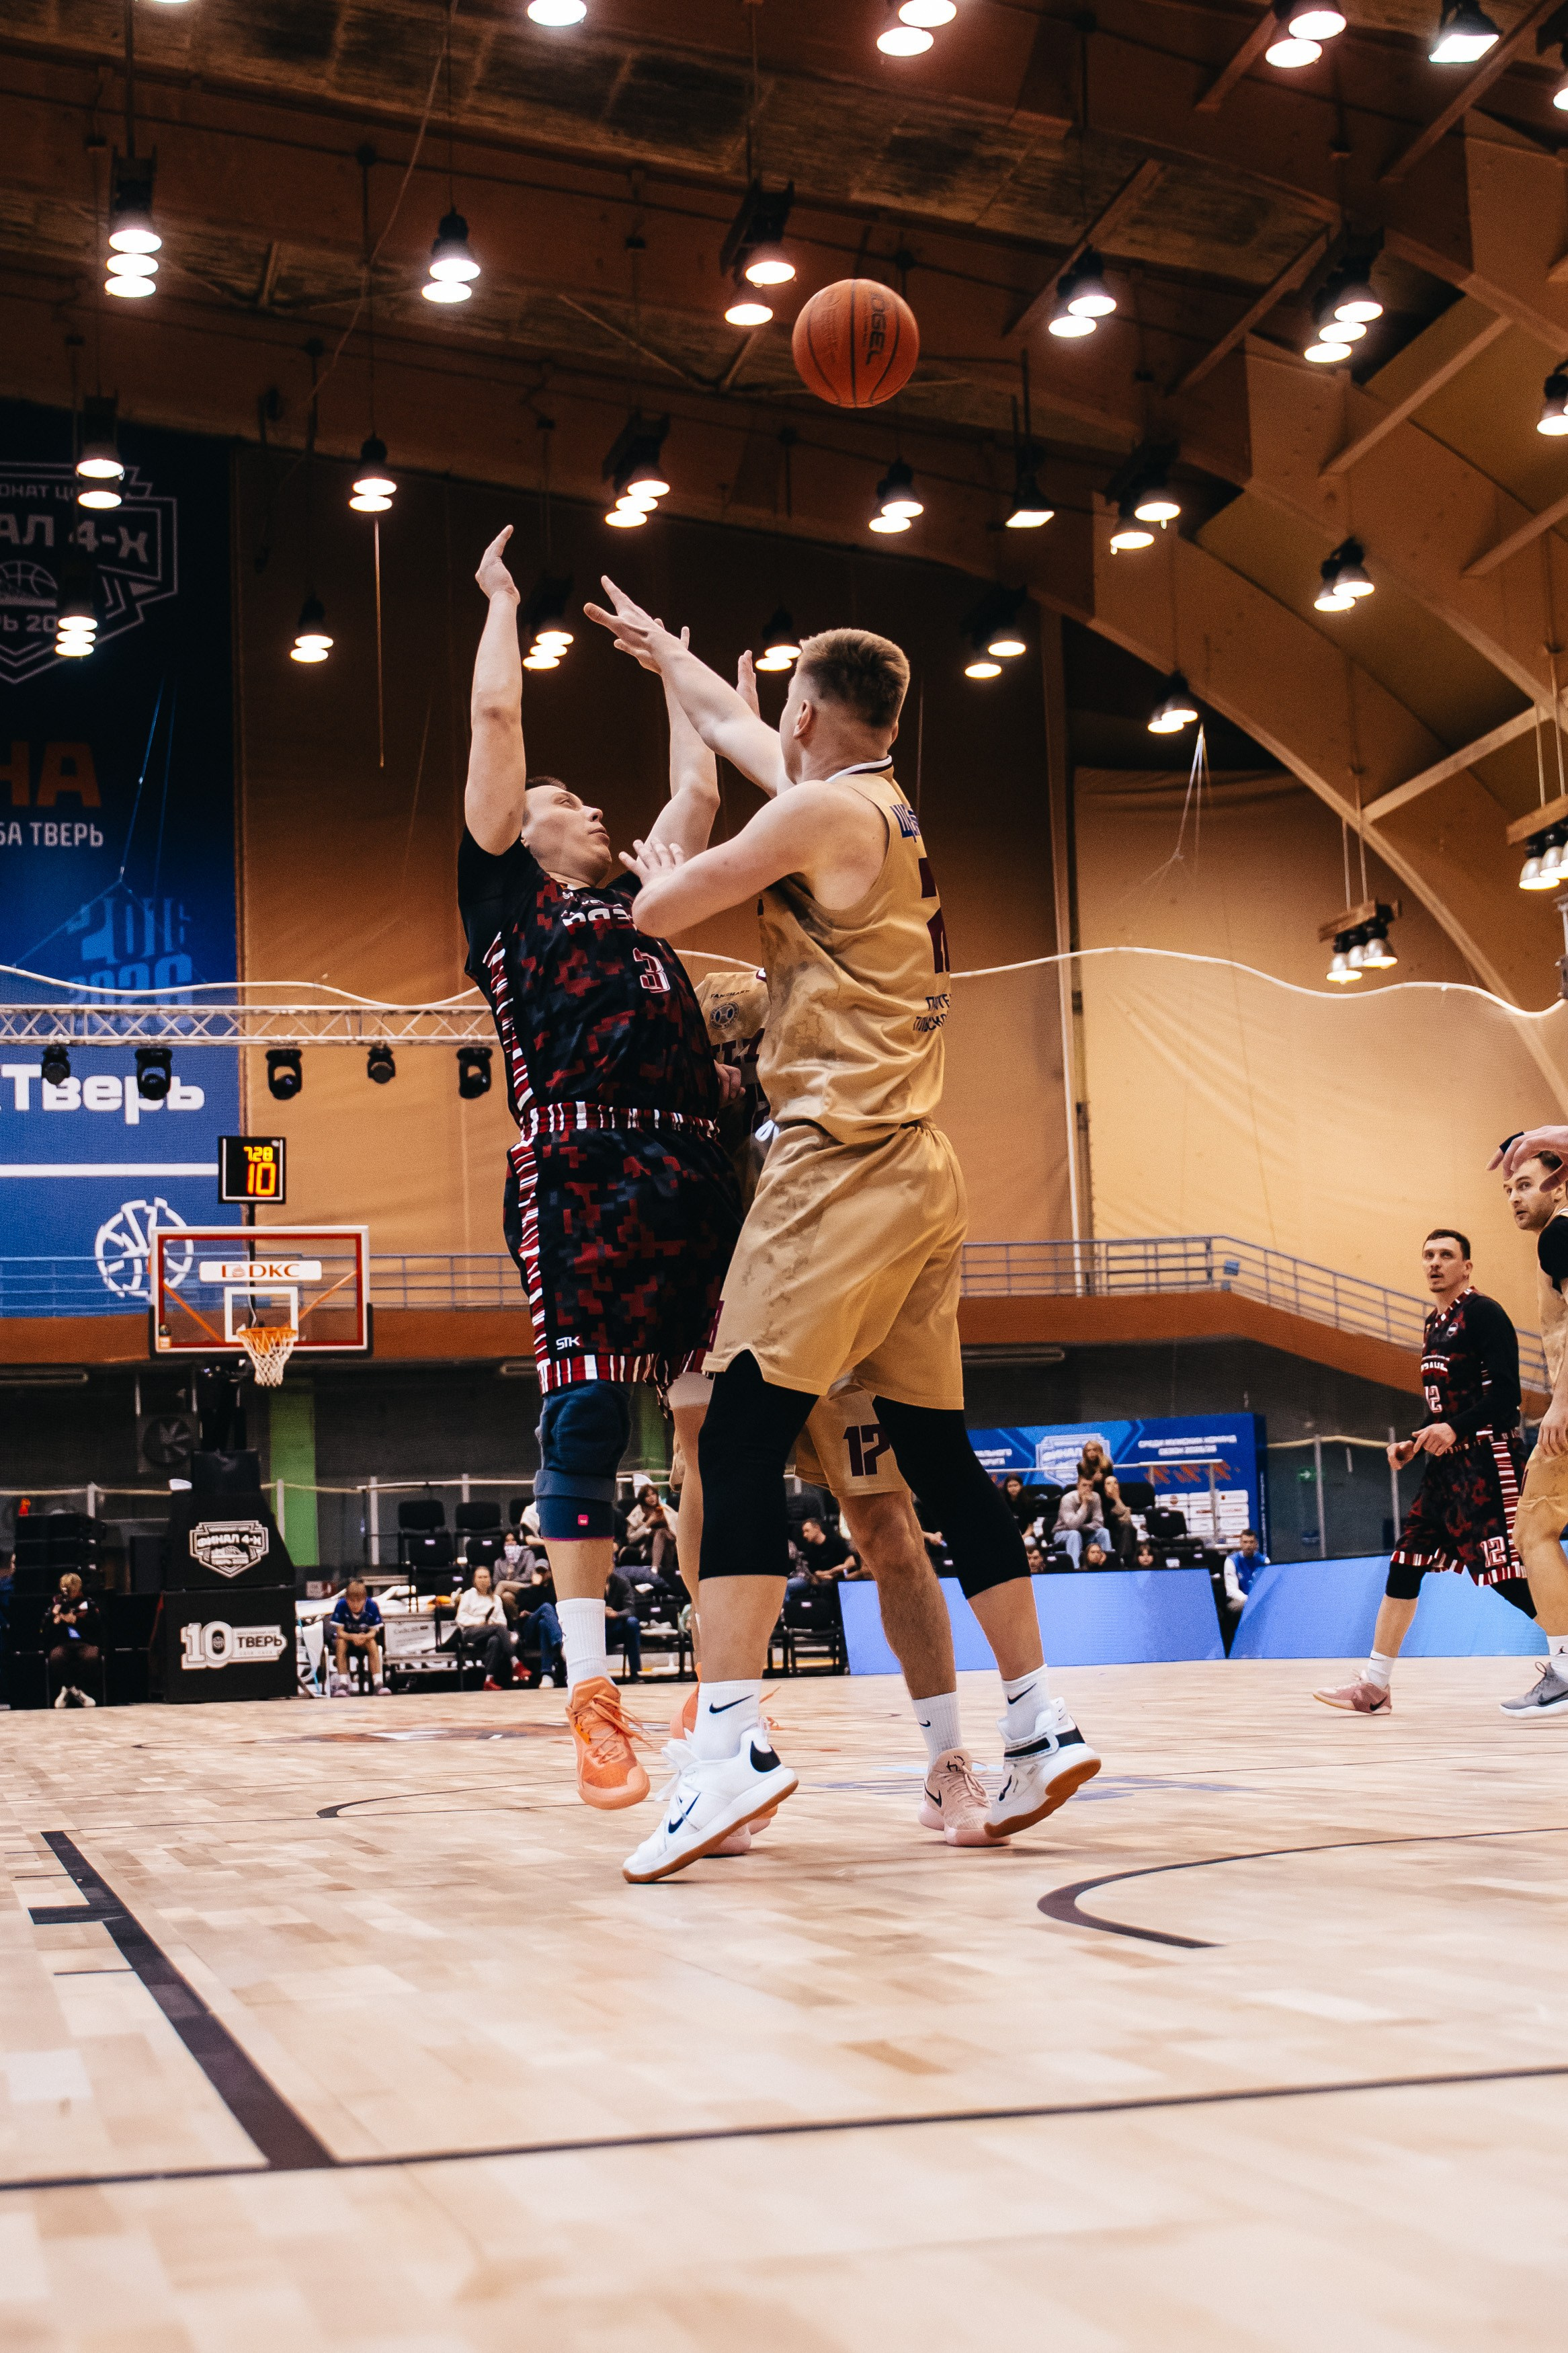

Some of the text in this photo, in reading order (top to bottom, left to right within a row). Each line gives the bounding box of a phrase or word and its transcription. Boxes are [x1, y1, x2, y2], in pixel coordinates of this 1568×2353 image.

[30, 822, 104, 847] ТВЕРЬ
[632, 947, 671, 994] 3
[1, 1064, 205, 1125] Тверь
[247, 1162, 276, 1196] 10
[556, 1336, 580, 1350] STK
[1480, 1536, 1507, 1568] 12
[237, 1635, 282, 1648] ТВЕРЬ
